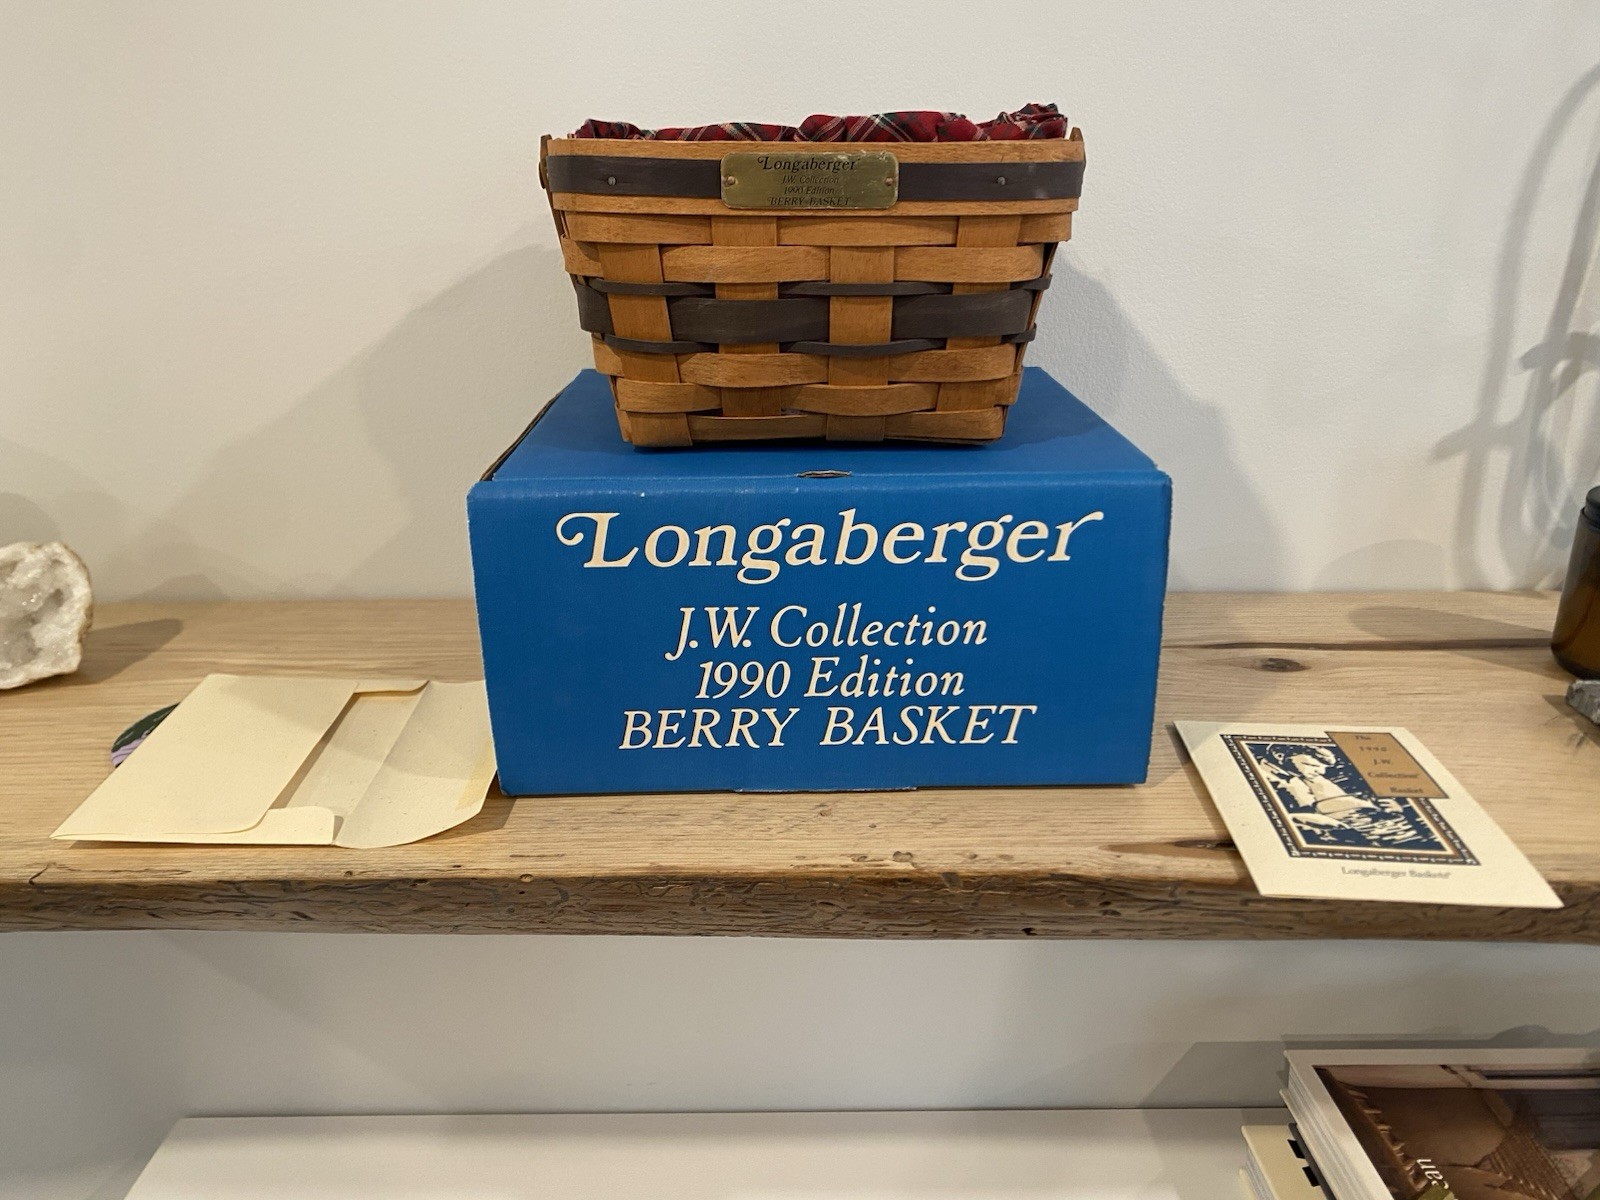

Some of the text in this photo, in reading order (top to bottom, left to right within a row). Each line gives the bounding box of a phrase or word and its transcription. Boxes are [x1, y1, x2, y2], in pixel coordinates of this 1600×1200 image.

[757, 156, 862, 174] Longaberger
[800, 175, 839, 184] Collection
[769, 197, 850, 206] BERRY BASKET
[806, 186, 834, 194] Edition
[555, 508, 1104, 585] Longaberger
[665, 602, 987, 661] J.W. Collection
[695, 654, 964, 699] 1990 Edition
[618, 705, 1038, 750] BERRY BASKET
